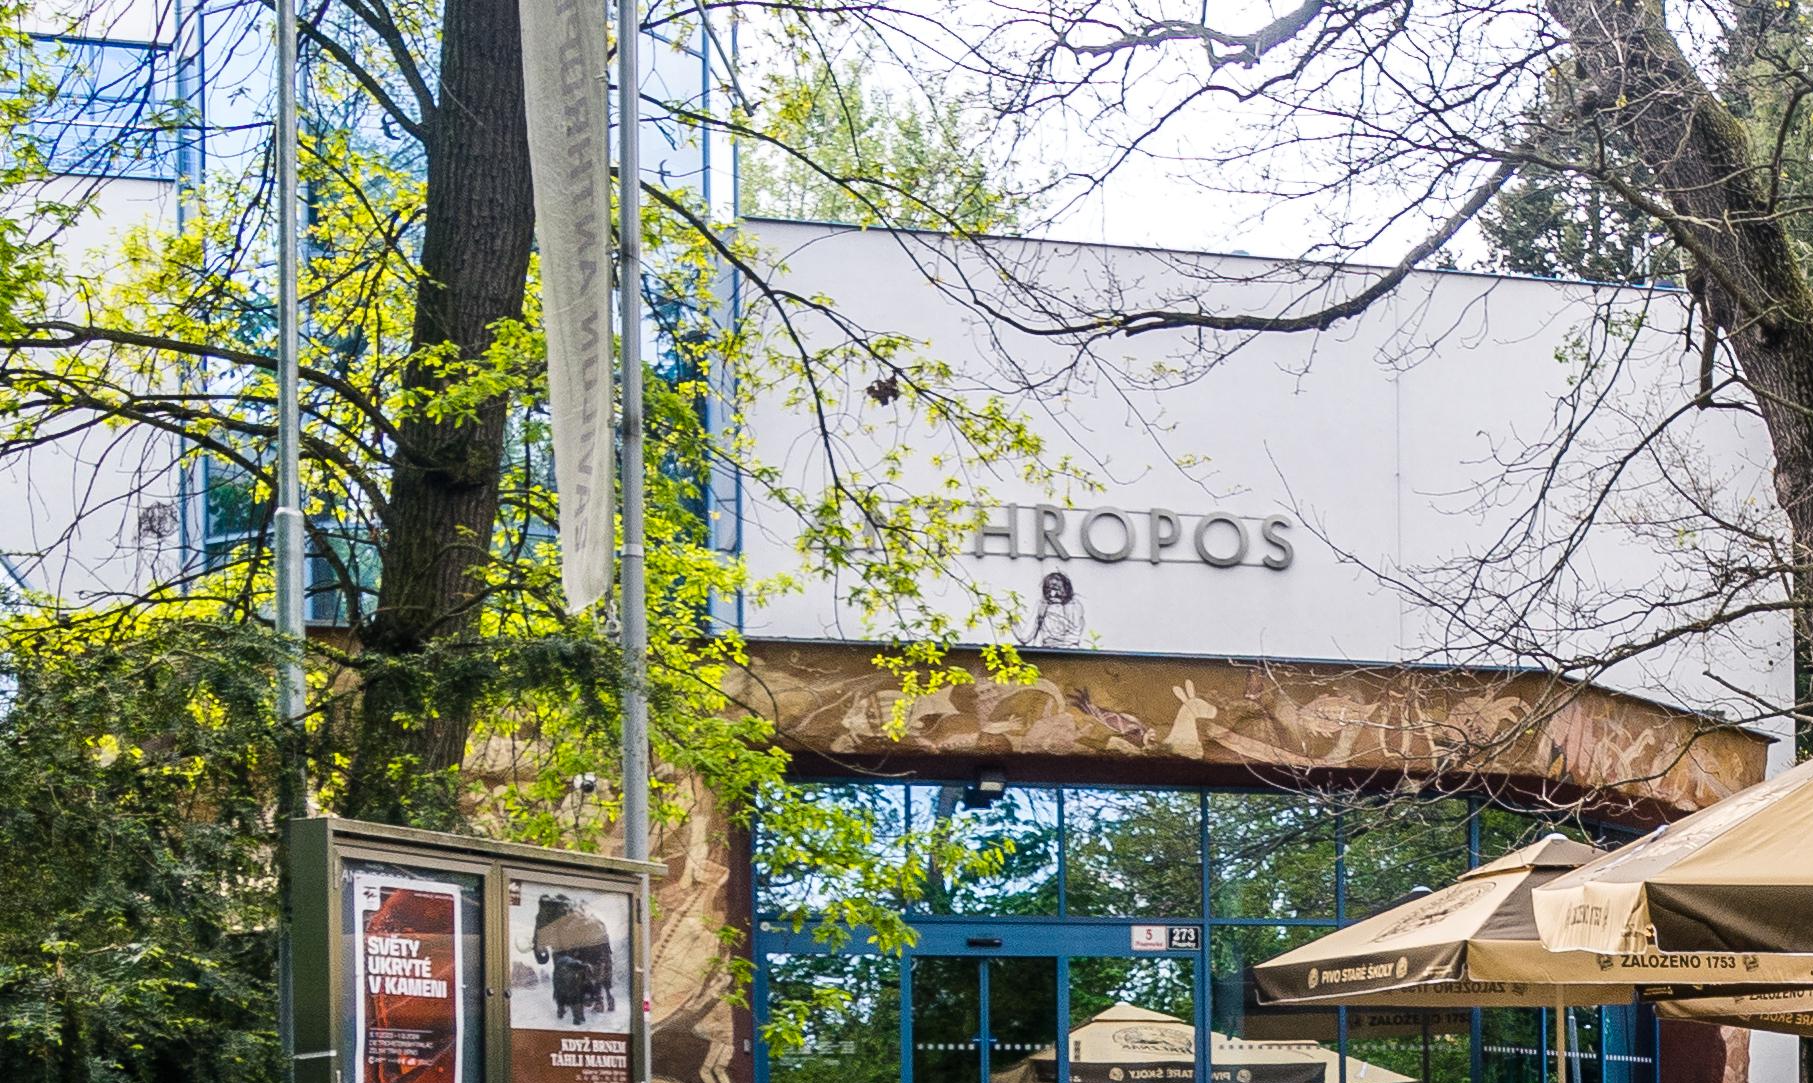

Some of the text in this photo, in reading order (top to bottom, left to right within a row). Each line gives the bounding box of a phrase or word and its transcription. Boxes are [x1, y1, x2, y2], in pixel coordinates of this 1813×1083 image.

[1145, 928, 1153, 940] 5
[1172, 928, 1196, 941] 273
[367, 934, 420, 957] SVĚTY
[367, 956, 432, 978] UKRYTÉ
[1706, 956, 1736, 969] 1753
[368, 975, 448, 998] V KAMENI
[561, 1036, 591, 1052] KDYŽ
[550, 1050, 627, 1068] TÁHLI MAMUTI
